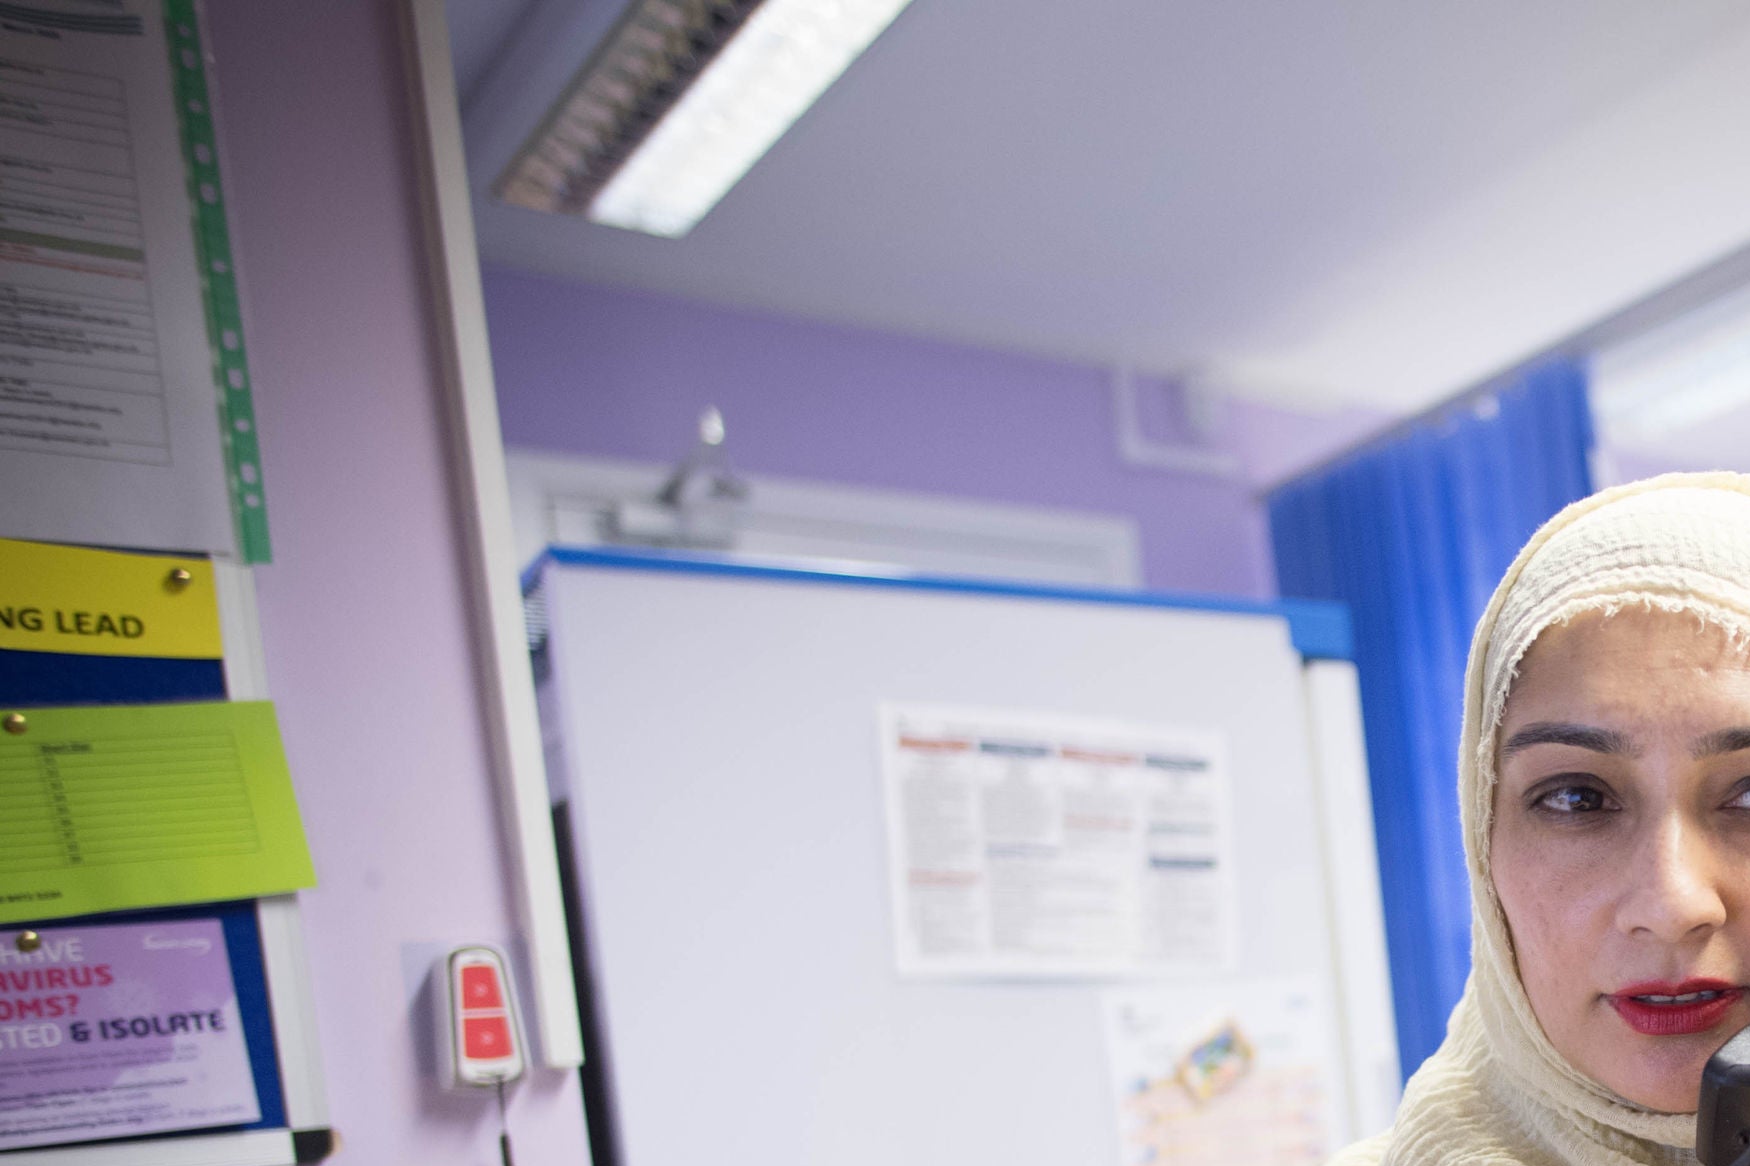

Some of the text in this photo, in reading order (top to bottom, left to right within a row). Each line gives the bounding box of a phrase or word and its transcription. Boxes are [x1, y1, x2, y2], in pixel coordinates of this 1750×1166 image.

[54, 608, 145, 639] LEAD
[0, 1008, 226, 1050] TED & ISOLATE
